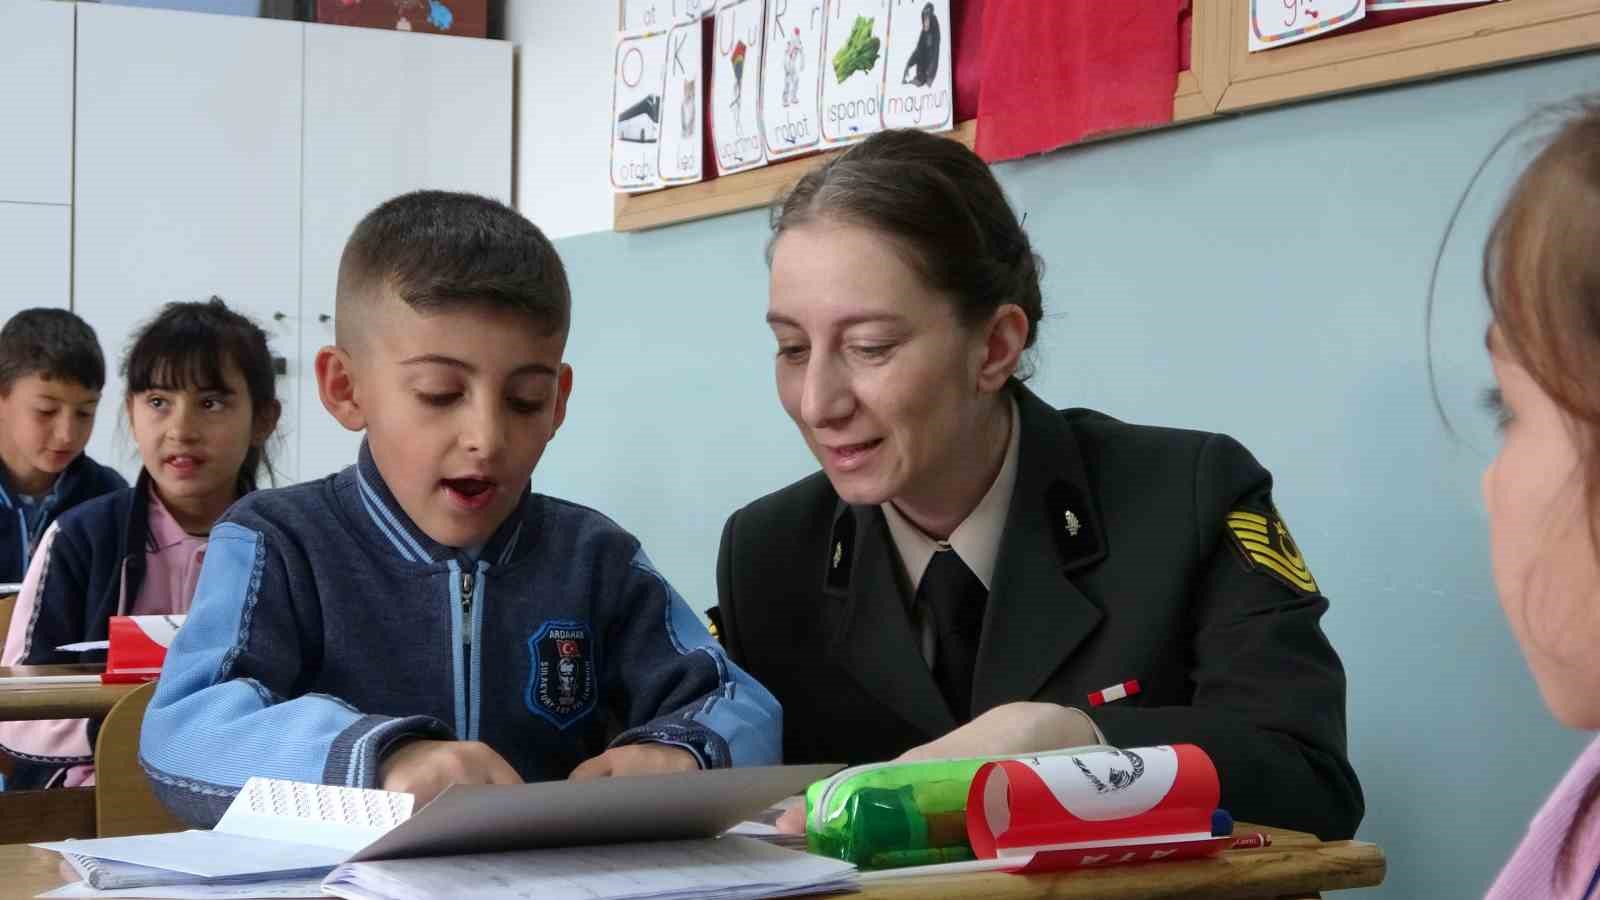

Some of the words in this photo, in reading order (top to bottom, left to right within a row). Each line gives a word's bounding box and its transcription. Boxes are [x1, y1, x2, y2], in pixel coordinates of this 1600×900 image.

[719, 8, 736, 56] U
[771, 0, 788, 41] R
[622, 48, 644, 88] O
[672, 33, 688, 76] K
[775, 112, 811, 141] robot
[549, 630, 585, 640] ARDAHAN
